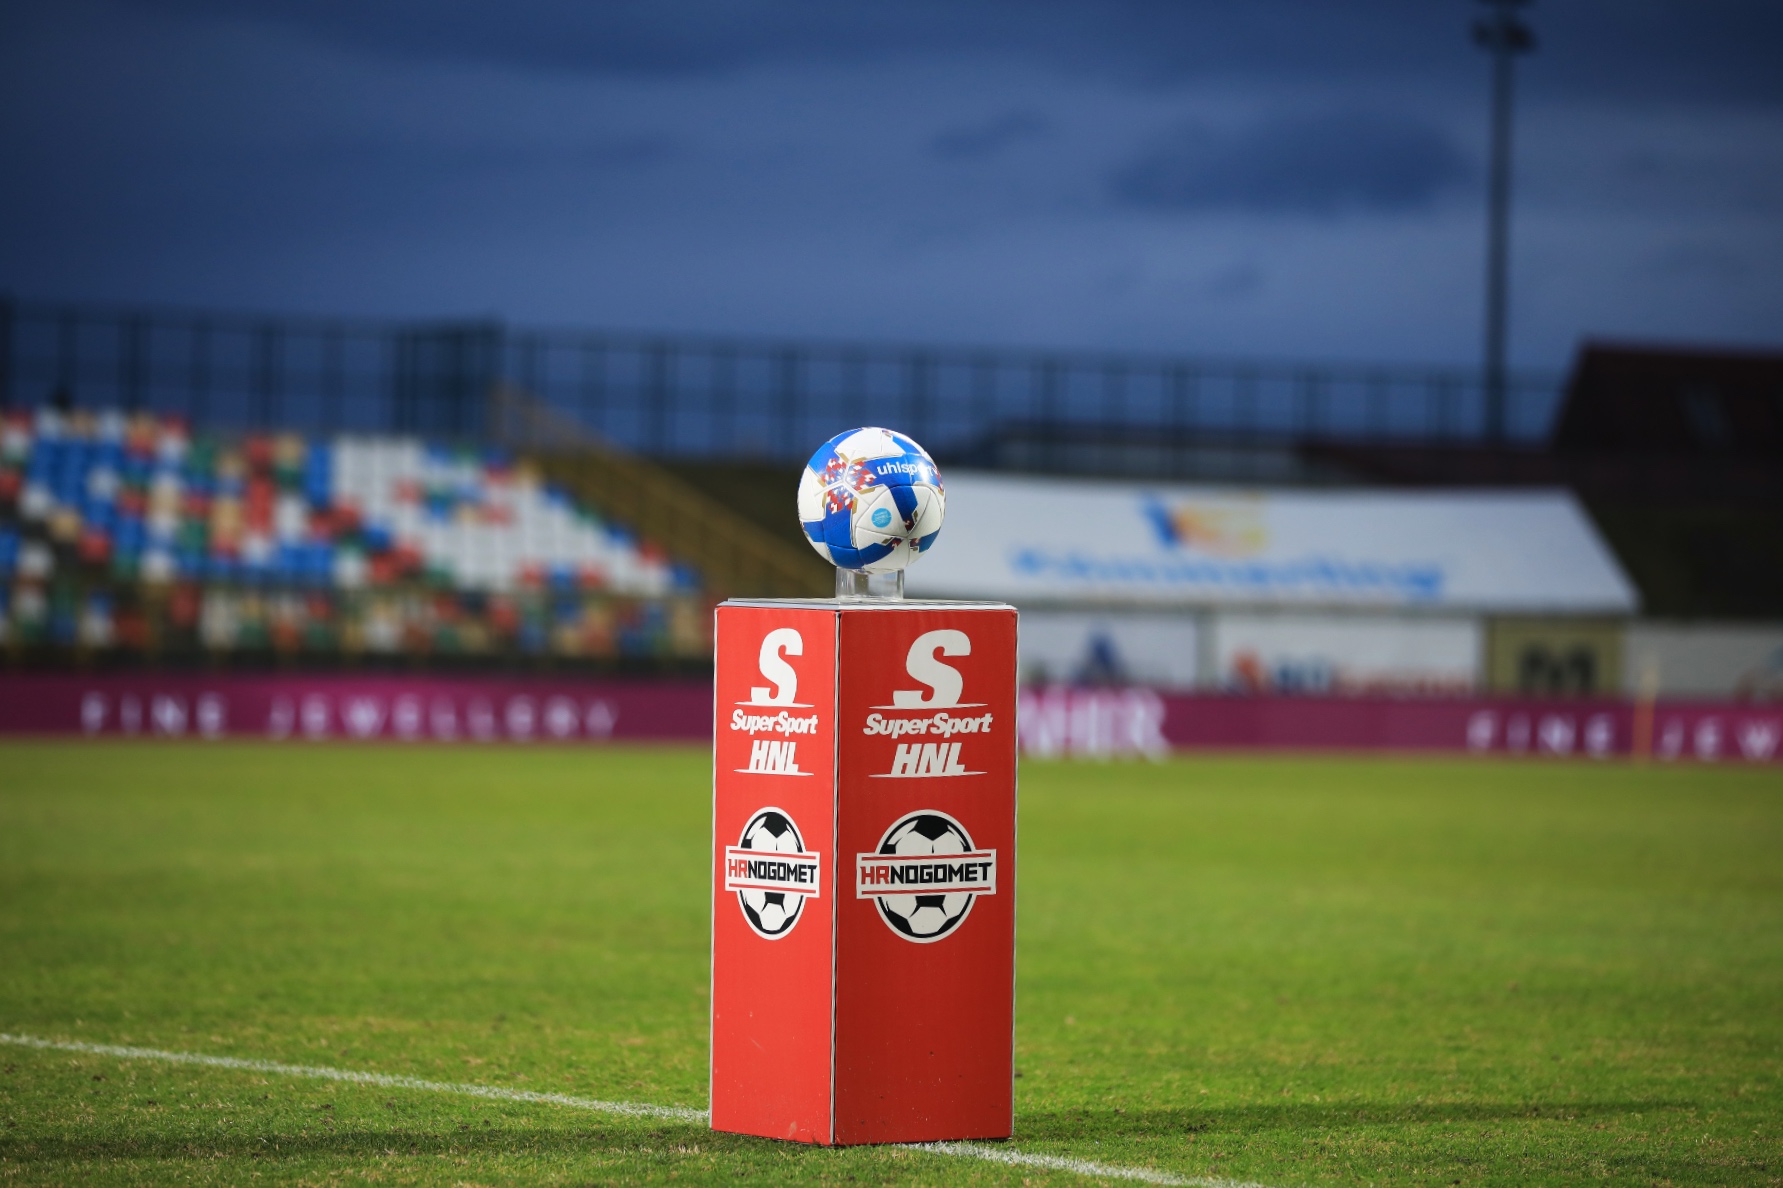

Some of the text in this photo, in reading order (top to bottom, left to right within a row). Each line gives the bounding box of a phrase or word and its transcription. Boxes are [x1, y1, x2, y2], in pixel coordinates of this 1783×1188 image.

[730, 709, 819, 736] SuperSport
[863, 712, 994, 739] SuperSport
[748, 739, 800, 774] HNL
[890, 742, 967, 777] HNL
[727, 858, 818, 885] HRNOGOMET
[860, 861, 994, 885] HRNOGOMET
